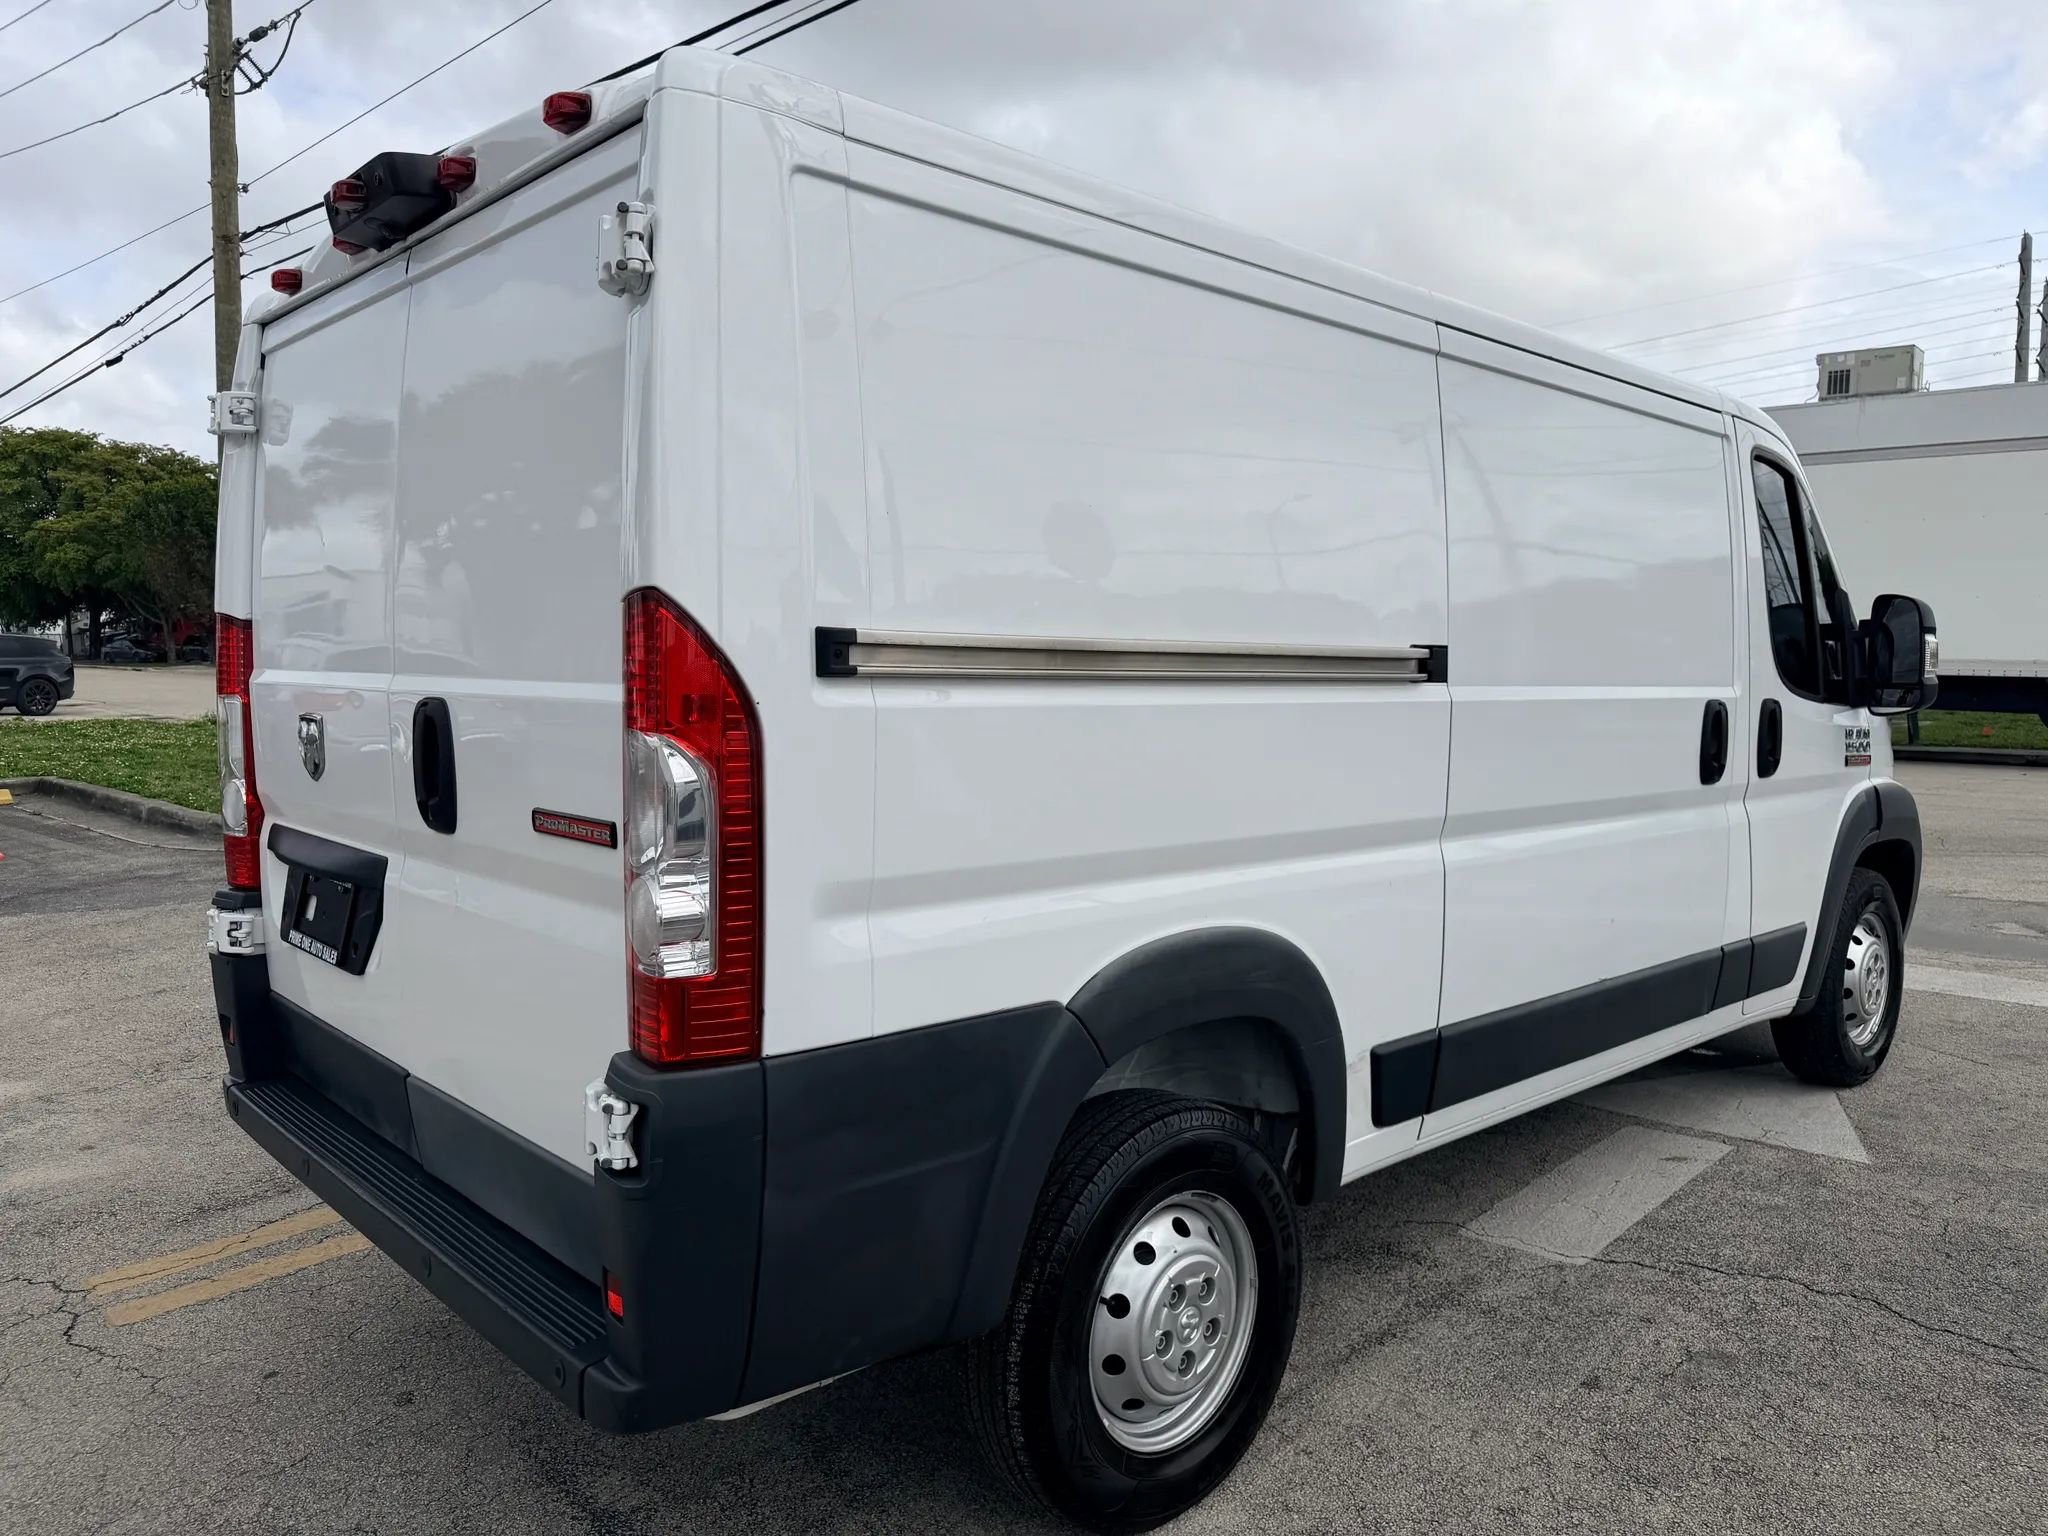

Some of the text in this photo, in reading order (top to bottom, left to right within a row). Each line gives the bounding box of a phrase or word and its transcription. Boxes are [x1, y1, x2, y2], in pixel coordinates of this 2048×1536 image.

[289, 929, 338, 964] PRIME ONE AUTO SALES
[1257, 1170, 1296, 1251] MAVIS
